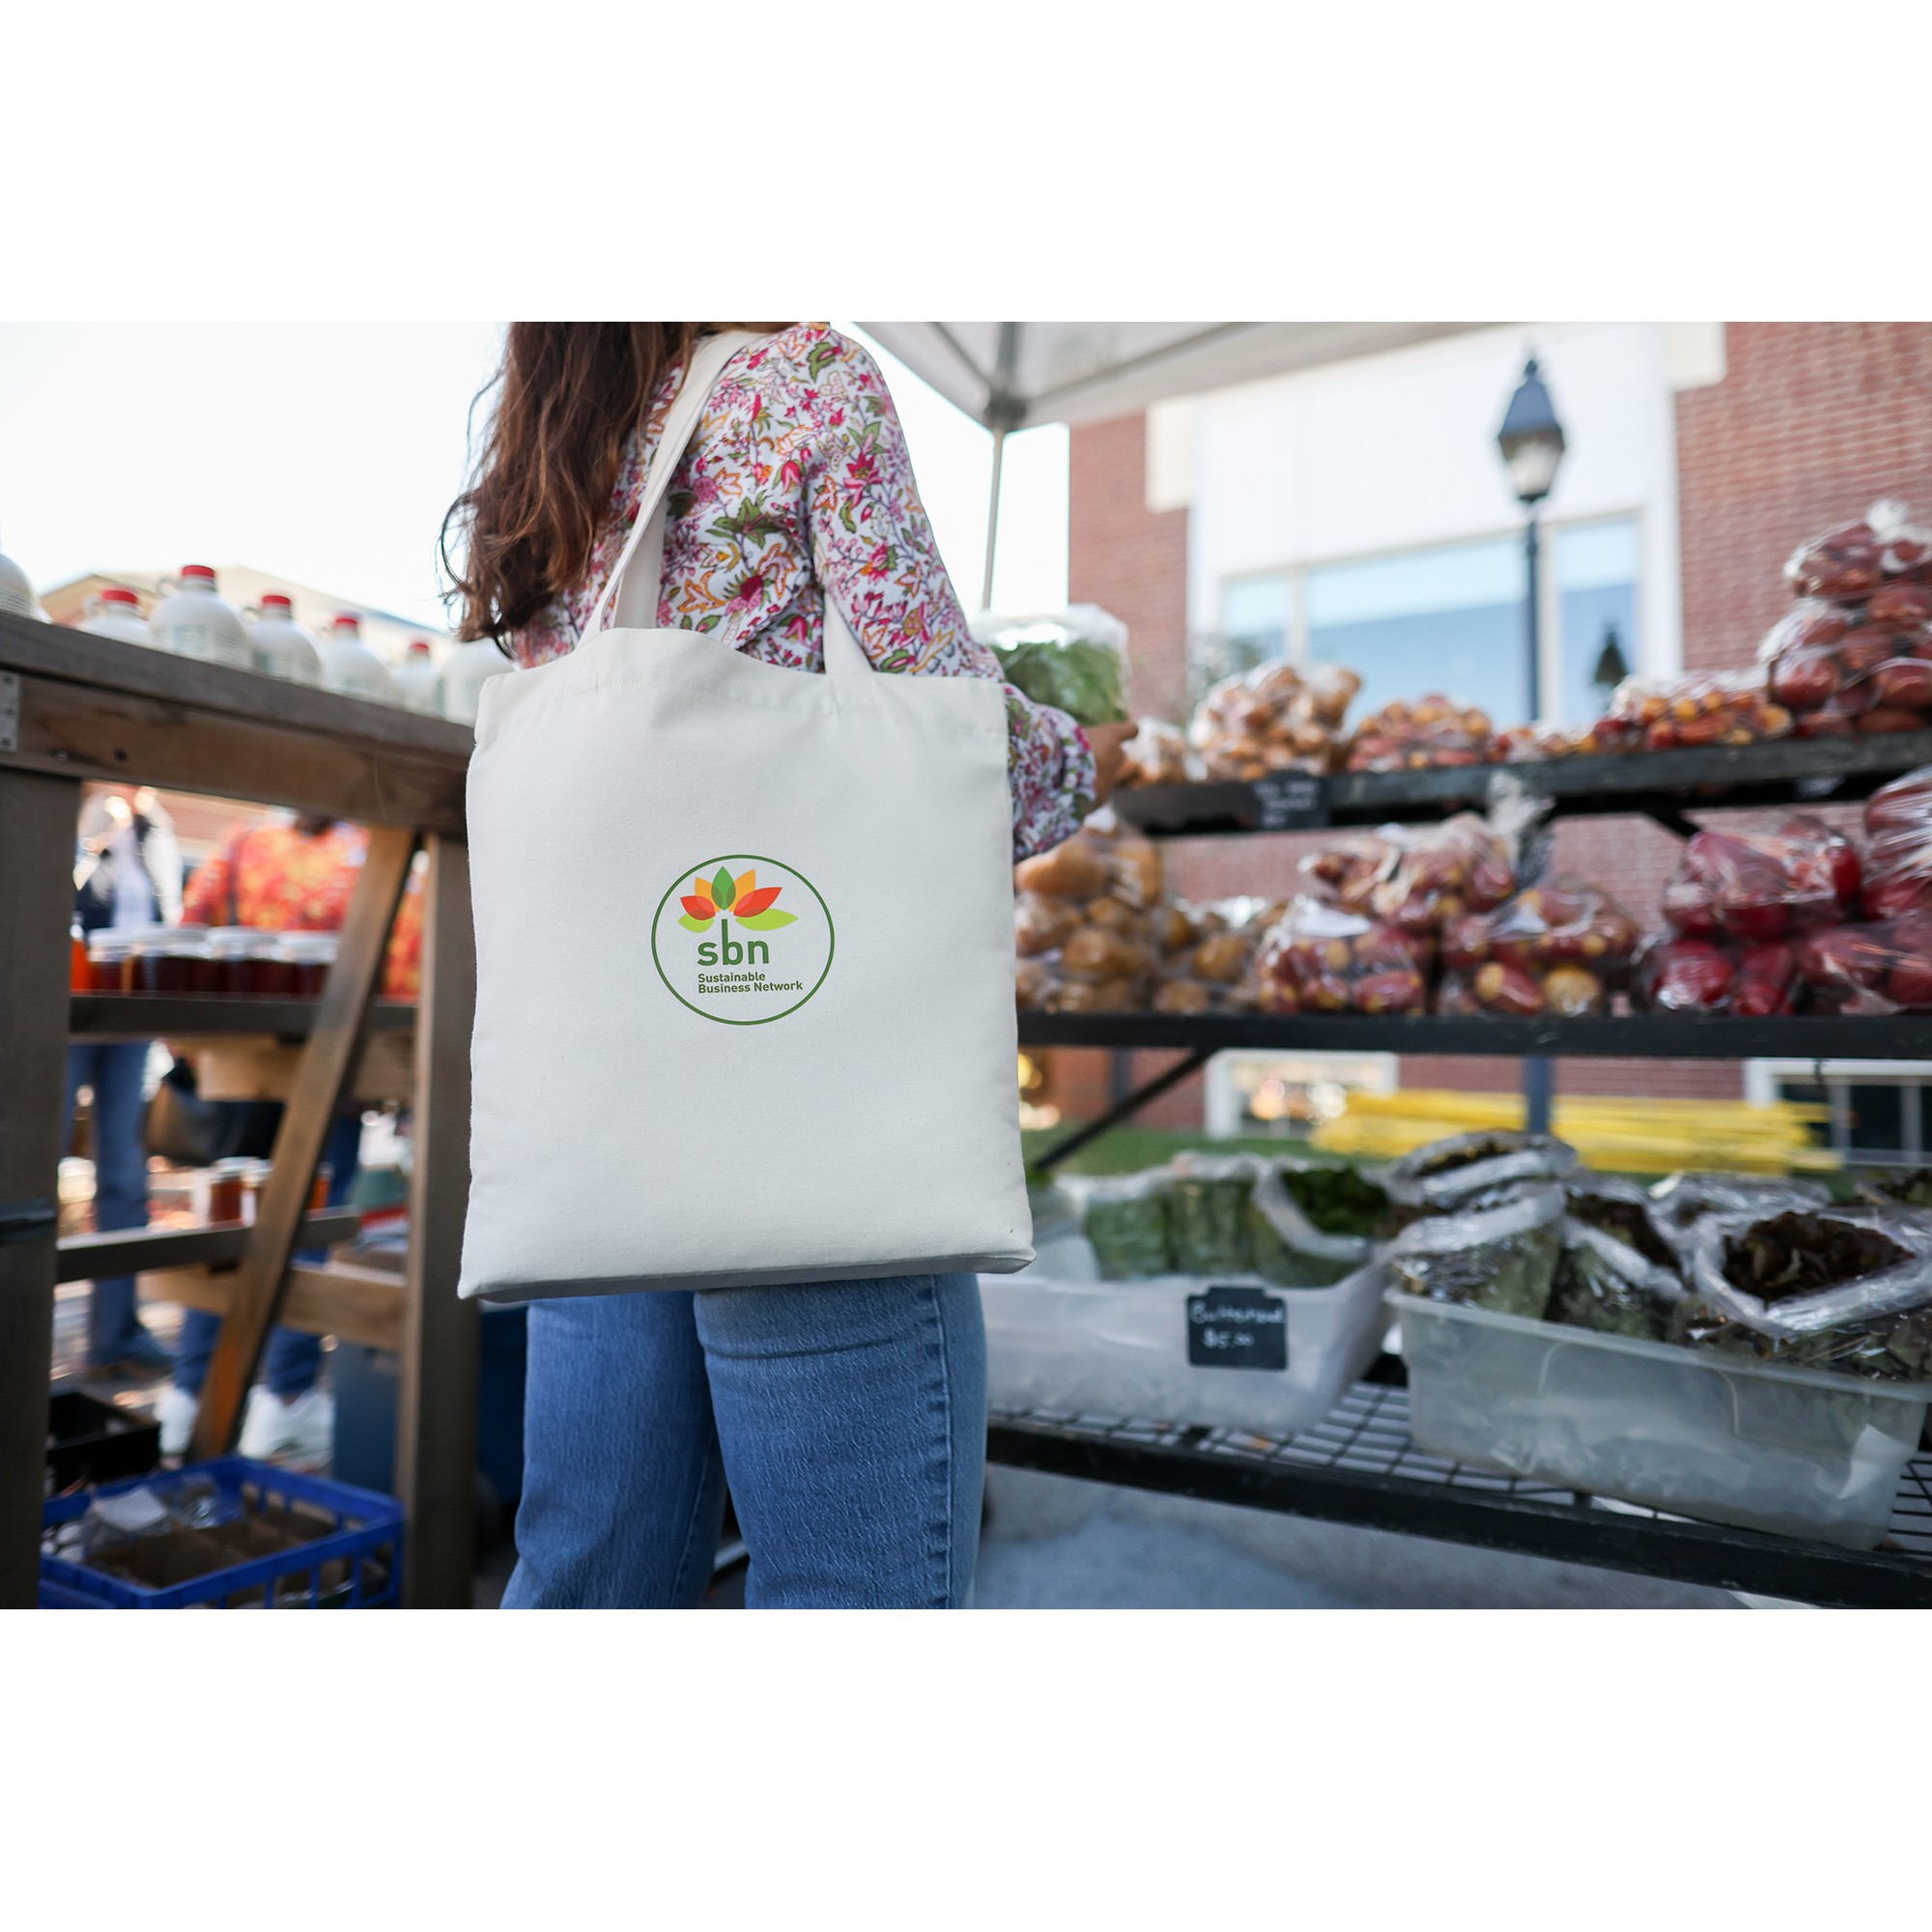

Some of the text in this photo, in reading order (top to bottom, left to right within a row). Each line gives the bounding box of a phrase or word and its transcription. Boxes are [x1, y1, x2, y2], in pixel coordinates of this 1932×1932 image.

[697, 919, 769, 966] sbn
[697, 972, 766, 982] Sustainable
[698, 980, 804, 993] Business Network
